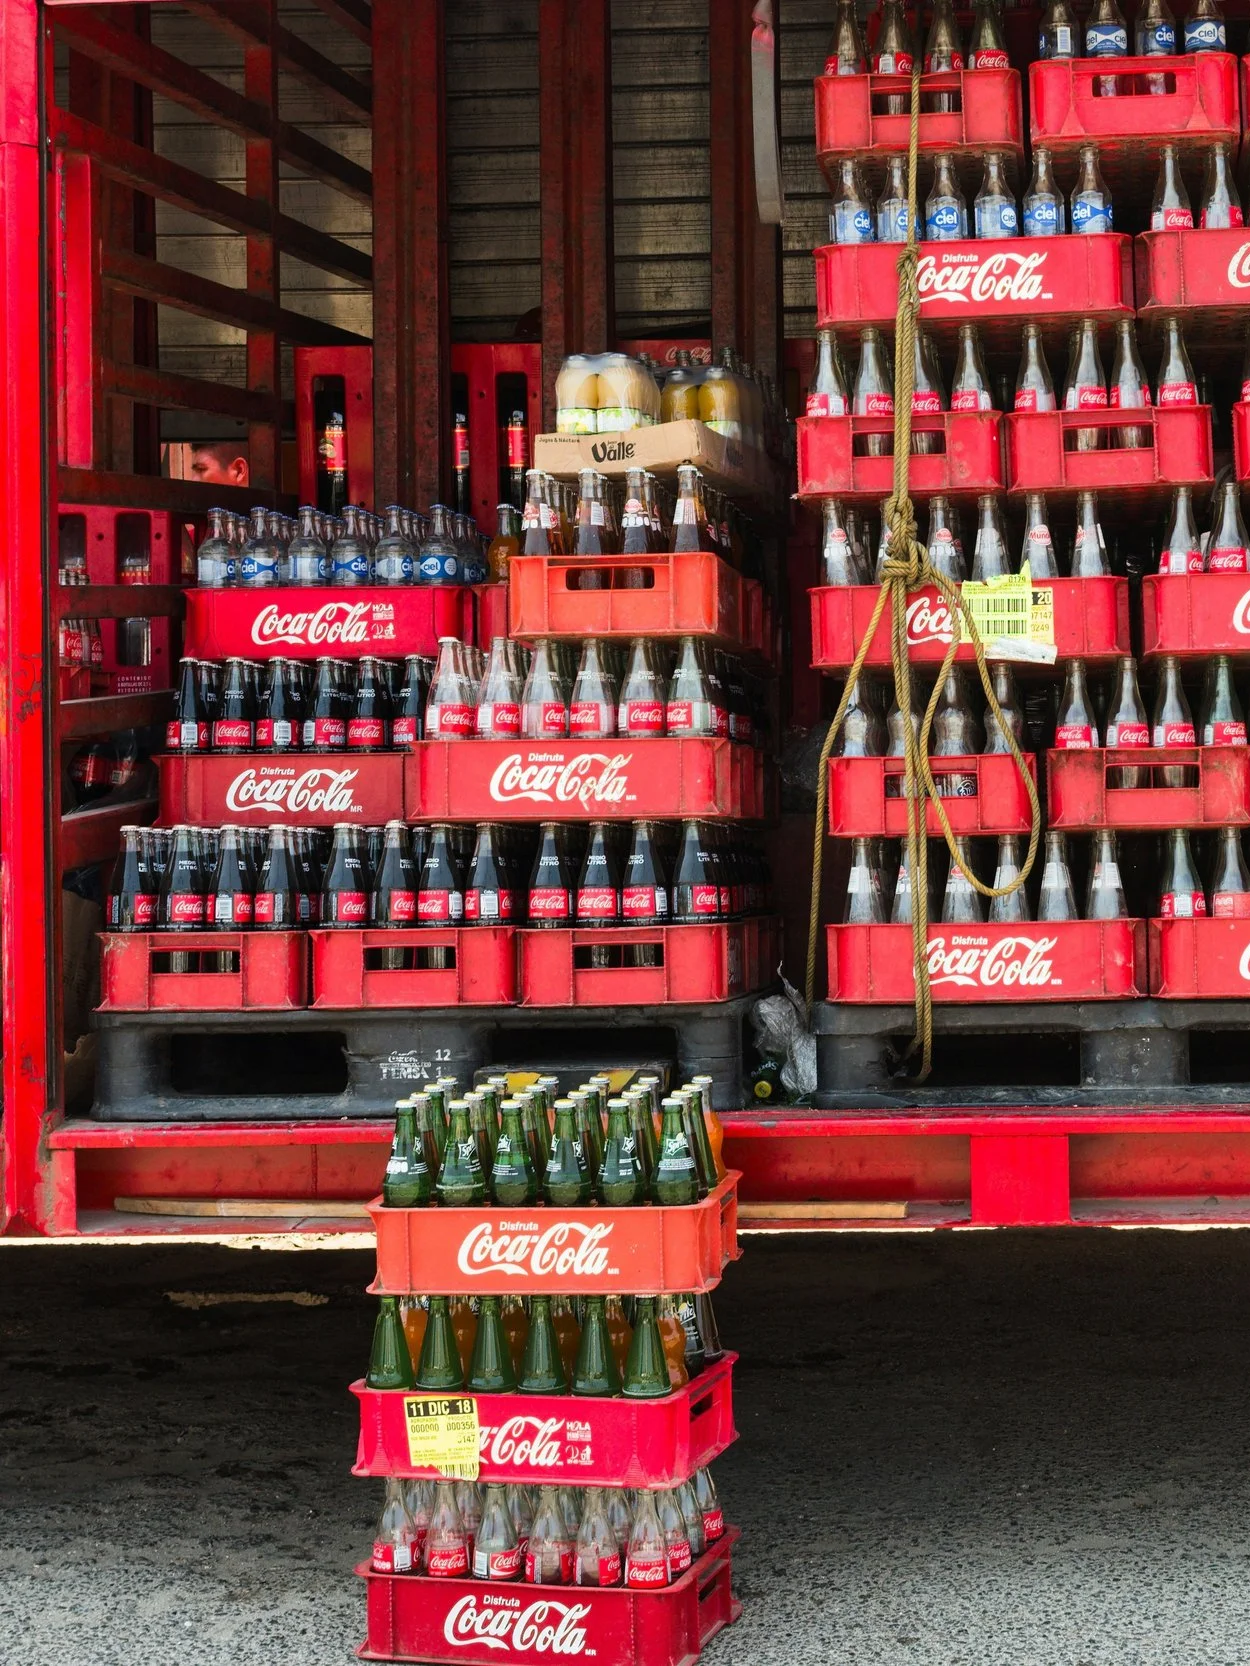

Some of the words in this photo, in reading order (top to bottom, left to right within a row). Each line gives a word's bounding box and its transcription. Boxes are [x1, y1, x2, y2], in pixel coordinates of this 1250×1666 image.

[1155, 28, 1175, 42] ciel
[1198, 27, 1216, 38] ciel
[935, 209, 958, 226] ciel
[1035, 204, 1057, 220] ciel
[1072, 203, 1092, 218] ciel
[942, 253, 979, 264] Disfruta
[591, 441, 635, 463] Valle
[1037, 592, 1052, 605] 20
[251, 601, 372, 645] Coca-Cola
[527, 752, 564, 762] Disfruta
[260, 767, 295, 776] Disfruta
[489, 752, 633, 803] Coca-Cola
[225, 768, 359, 813] Coca-Cola
[350, 805, 363, 813] MR
[529, 894, 566, 910] Coca-Cola
[578, 894, 613, 909] Coca-Cola
[952, 935, 988, 945] Disfruta
[435, 1048, 452, 1061] 12
[499, 1221, 538, 1232] Disfruta
[457, 1221, 615, 1277] Coca-Cola
[410, 1403, 424, 1416] 11
[428, 1401, 450, 1416] DIC
[456, 1399, 471, 1413] 18
[446, 1421, 475, 1431] 000356
[457, 1434, 476, 1443] 147
[479, 1416, 565, 1467] a-Cola
[430, 1553, 465, 1570] Coca-Cola
[629, 1566, 664, 1582] Coca-Cola
[483, 1594, 520, 1607] Disfruta
[443, 1594, 592, 1656] Coca-Cola
[584, 1648, 597, 1656] MR
